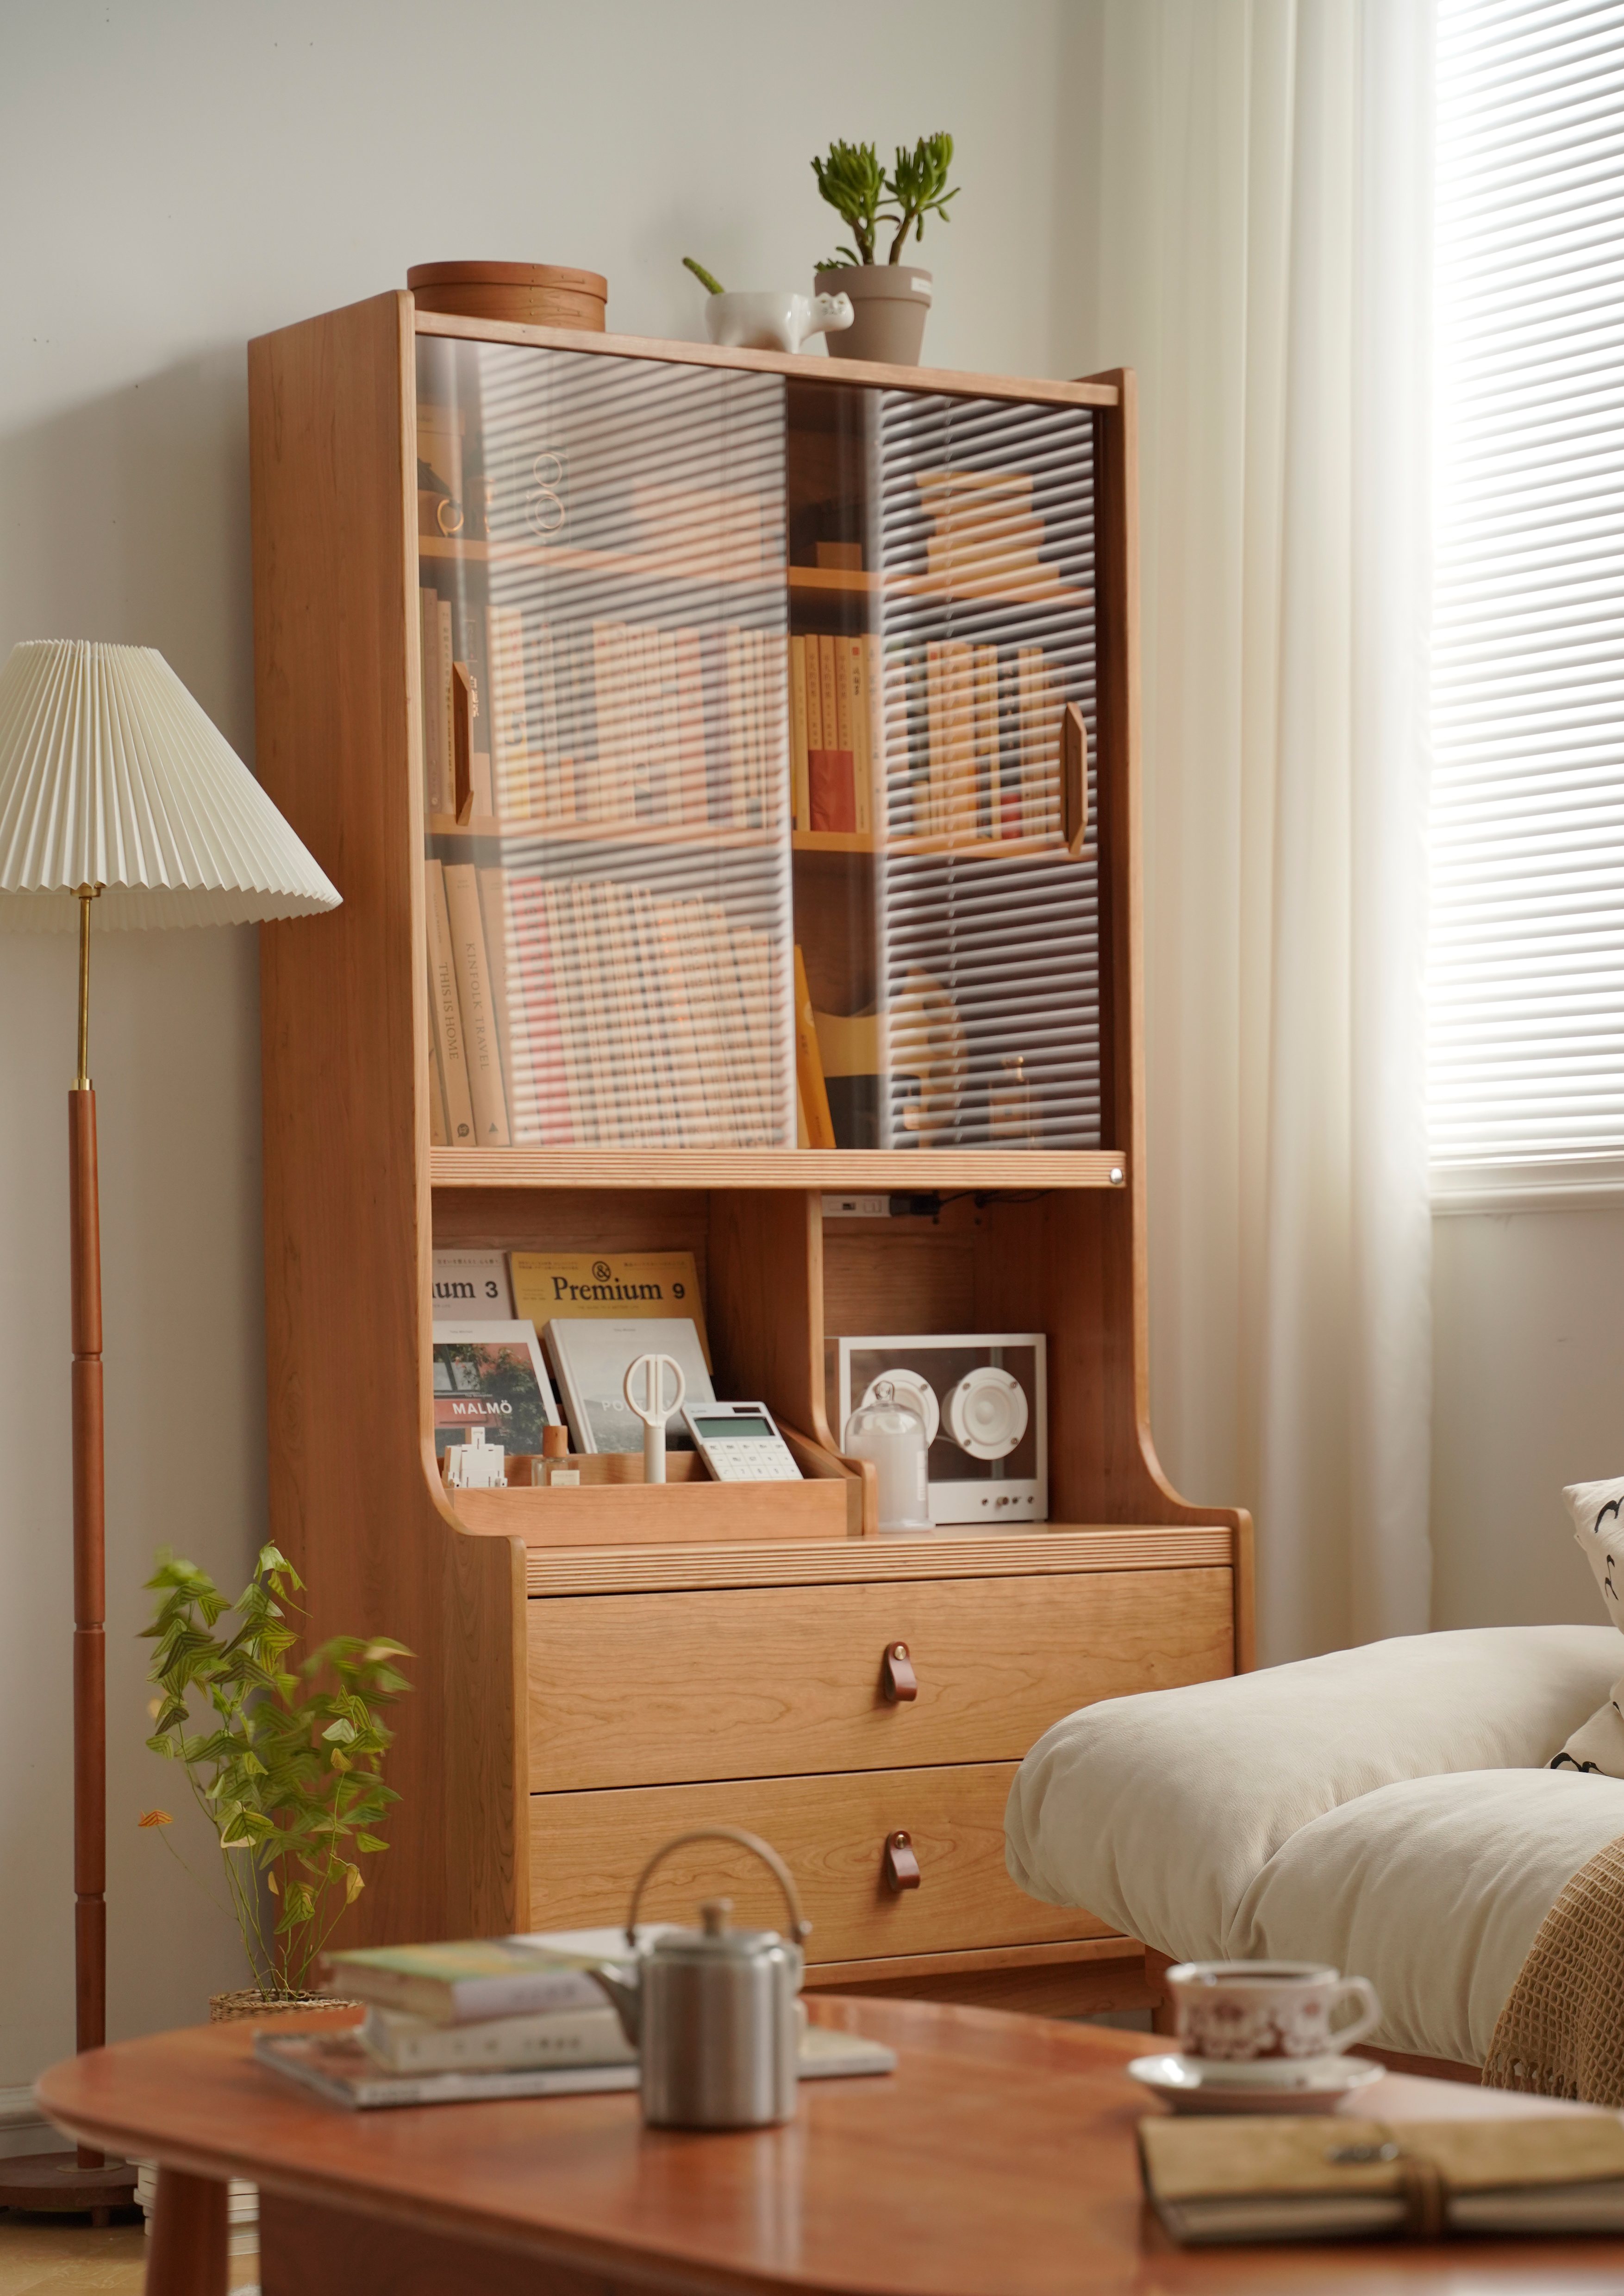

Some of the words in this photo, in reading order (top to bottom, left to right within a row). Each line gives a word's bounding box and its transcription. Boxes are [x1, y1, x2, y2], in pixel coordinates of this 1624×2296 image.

[438, 962, 451, 996] THIS
[443, 1001, 453, 1013] IS
[466, 943, 483, 1010] KINFOLK
[475, 1016, 489, 1070] TRAVEL
[445, 1017, 459, 1060] HOME
[485, 1281, 498, 1298] 3
[551, 1276, 663, 1300] Premium
[673, 1282, 685, 1299] 9
[452, 1400, 512, 1415] MALMÖ
